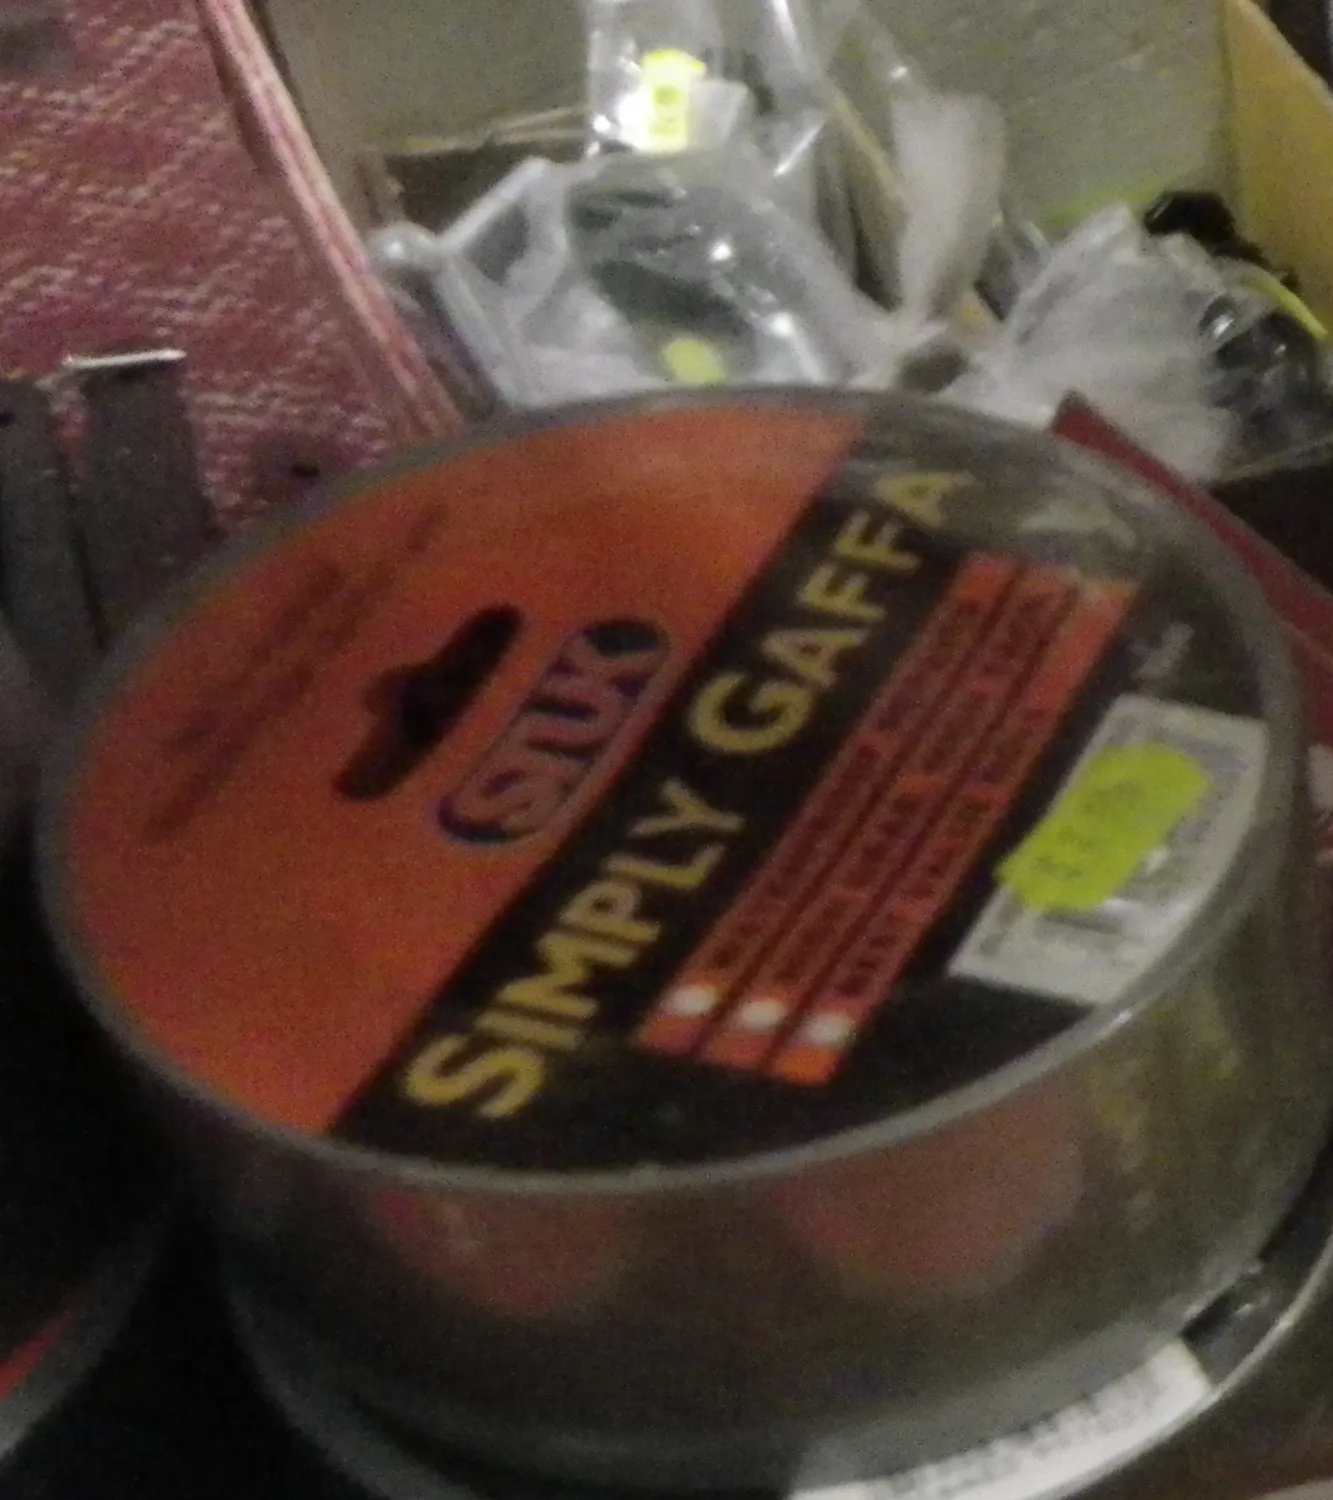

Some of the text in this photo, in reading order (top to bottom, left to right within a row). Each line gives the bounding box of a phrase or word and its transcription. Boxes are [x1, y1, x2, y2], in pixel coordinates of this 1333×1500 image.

[405, 468, 976, 1121] SIMPLY GAFFA
[450, 622, 662, 842] STUK
